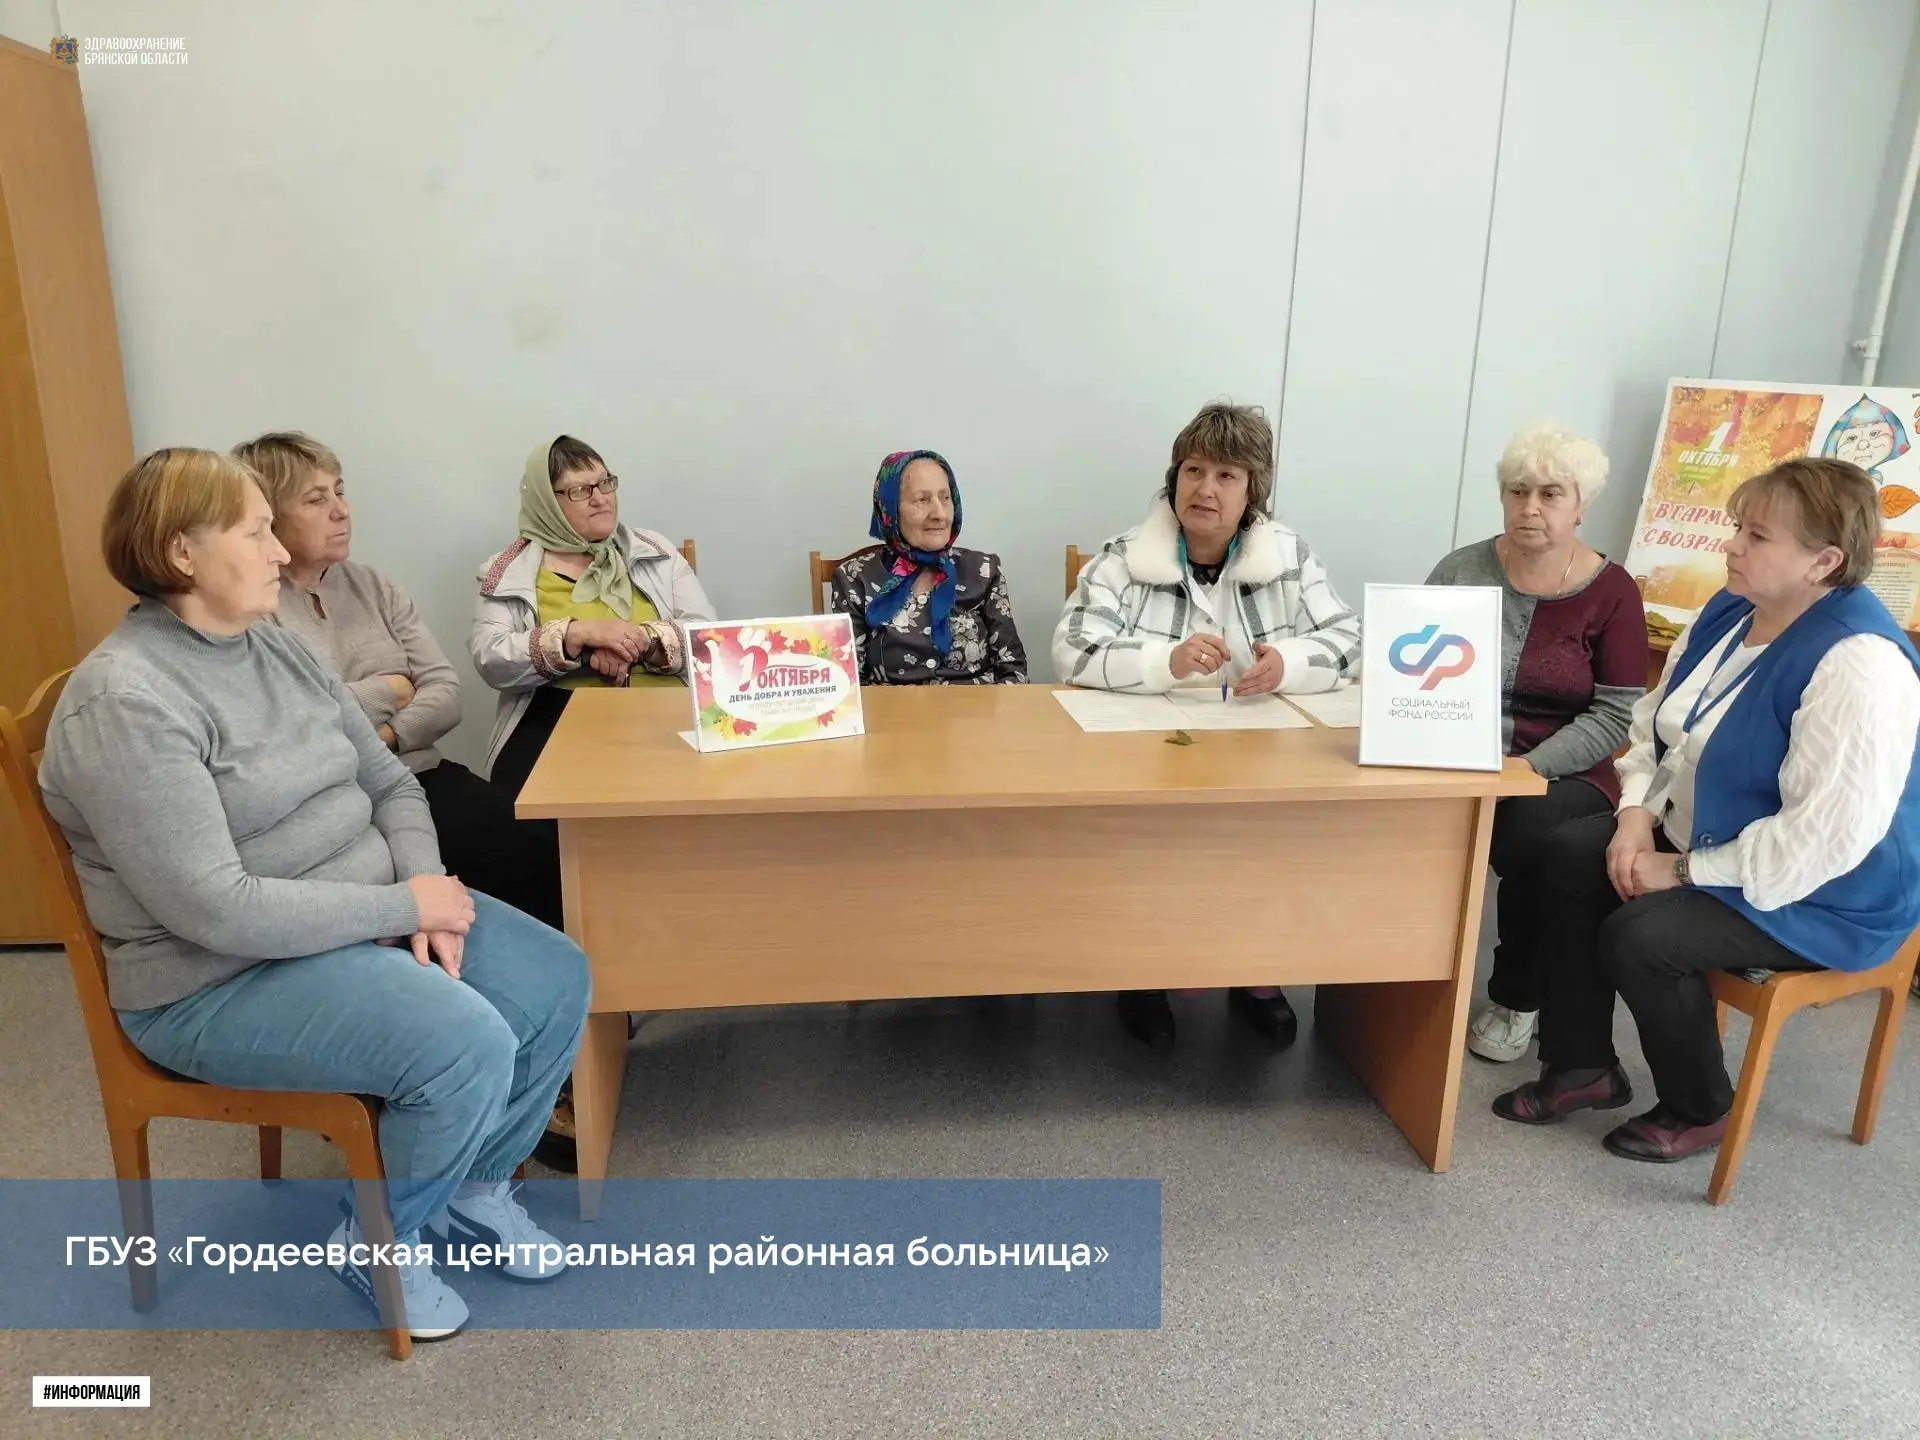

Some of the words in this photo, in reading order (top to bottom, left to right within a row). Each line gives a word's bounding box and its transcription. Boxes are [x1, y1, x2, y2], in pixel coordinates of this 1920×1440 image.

[1703, 421, 1735, 452] 1
[1678, 449, 1739, 468] ОКТЯБРЯ
[1671, 505, 1734, 527] ГАРМО
[1643, 528, 1658, 544] С
[757, 667, 830, 689] ОКТЯБРЯ
[729, 694, 752, 703] ДЕНЬ
[754, 690, 782, 701] ДОБРА
[783, 689, 791, 697] И
[791, 685, 837, 697] УВАЖЕНИЯ
[1391, 696, 1470, 710] СОЦИАЛЬНЫЙ
[1388, 708, 1422, 719] ФОНД
[1424, 710, 1473, 721] РОССИИ
